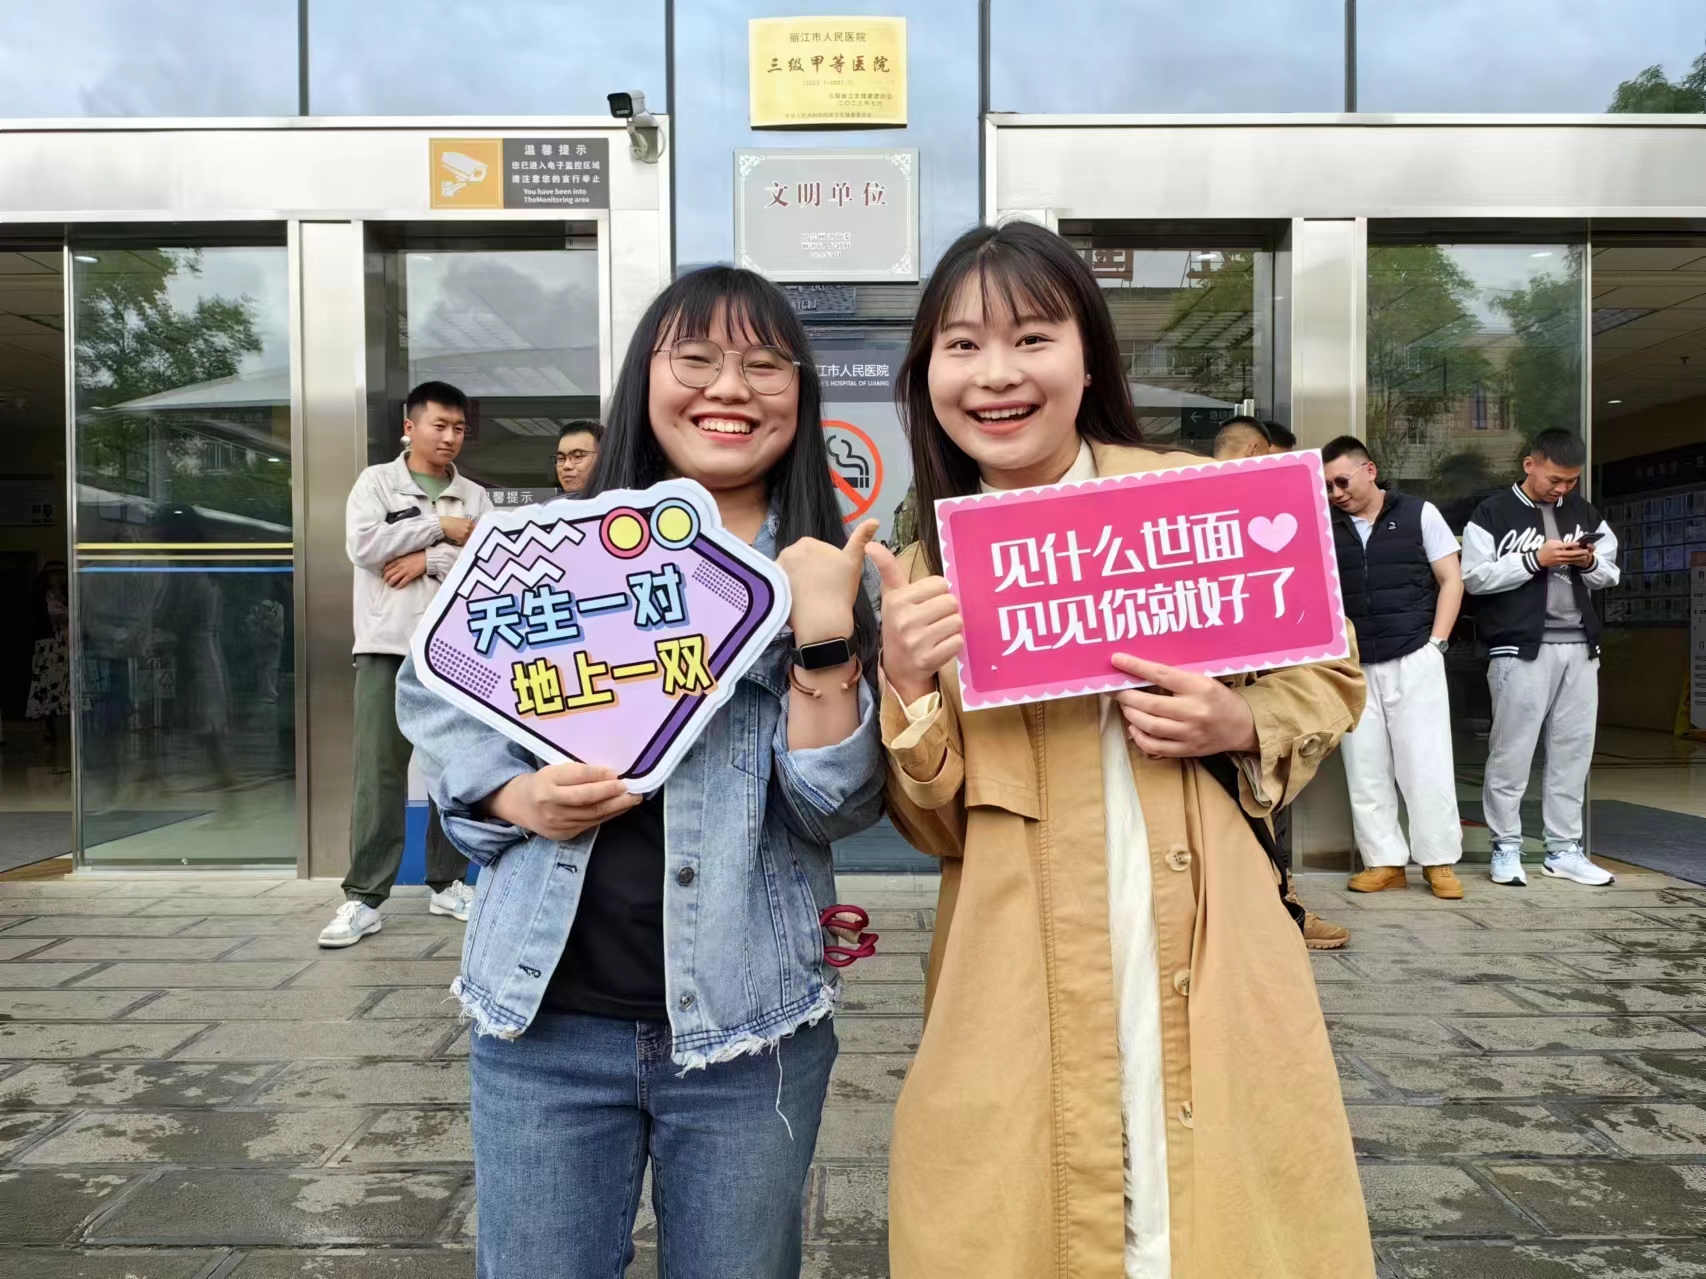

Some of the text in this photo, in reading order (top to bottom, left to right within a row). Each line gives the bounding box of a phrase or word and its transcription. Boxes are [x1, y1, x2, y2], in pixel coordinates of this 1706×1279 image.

[789, 32, 867, 43] 丽江市人民医院
[767, 53, 891, 74] 三级甲等医院
[524, 144, 588, 156] 温馨提示
[511, 161, 601, 170] 您已进入电子监控区域
[511, 174, 601, 184] 请注意您的言行举止
[764, 181, 888, 209] 文明单位
[990, 509, 1245, 593] 见什么世面
[466, 562, 690, 655] 天生一对
[997, 566, 1296, 658] 见见你就好了
[510, 633, 717, 717] 地上一双
